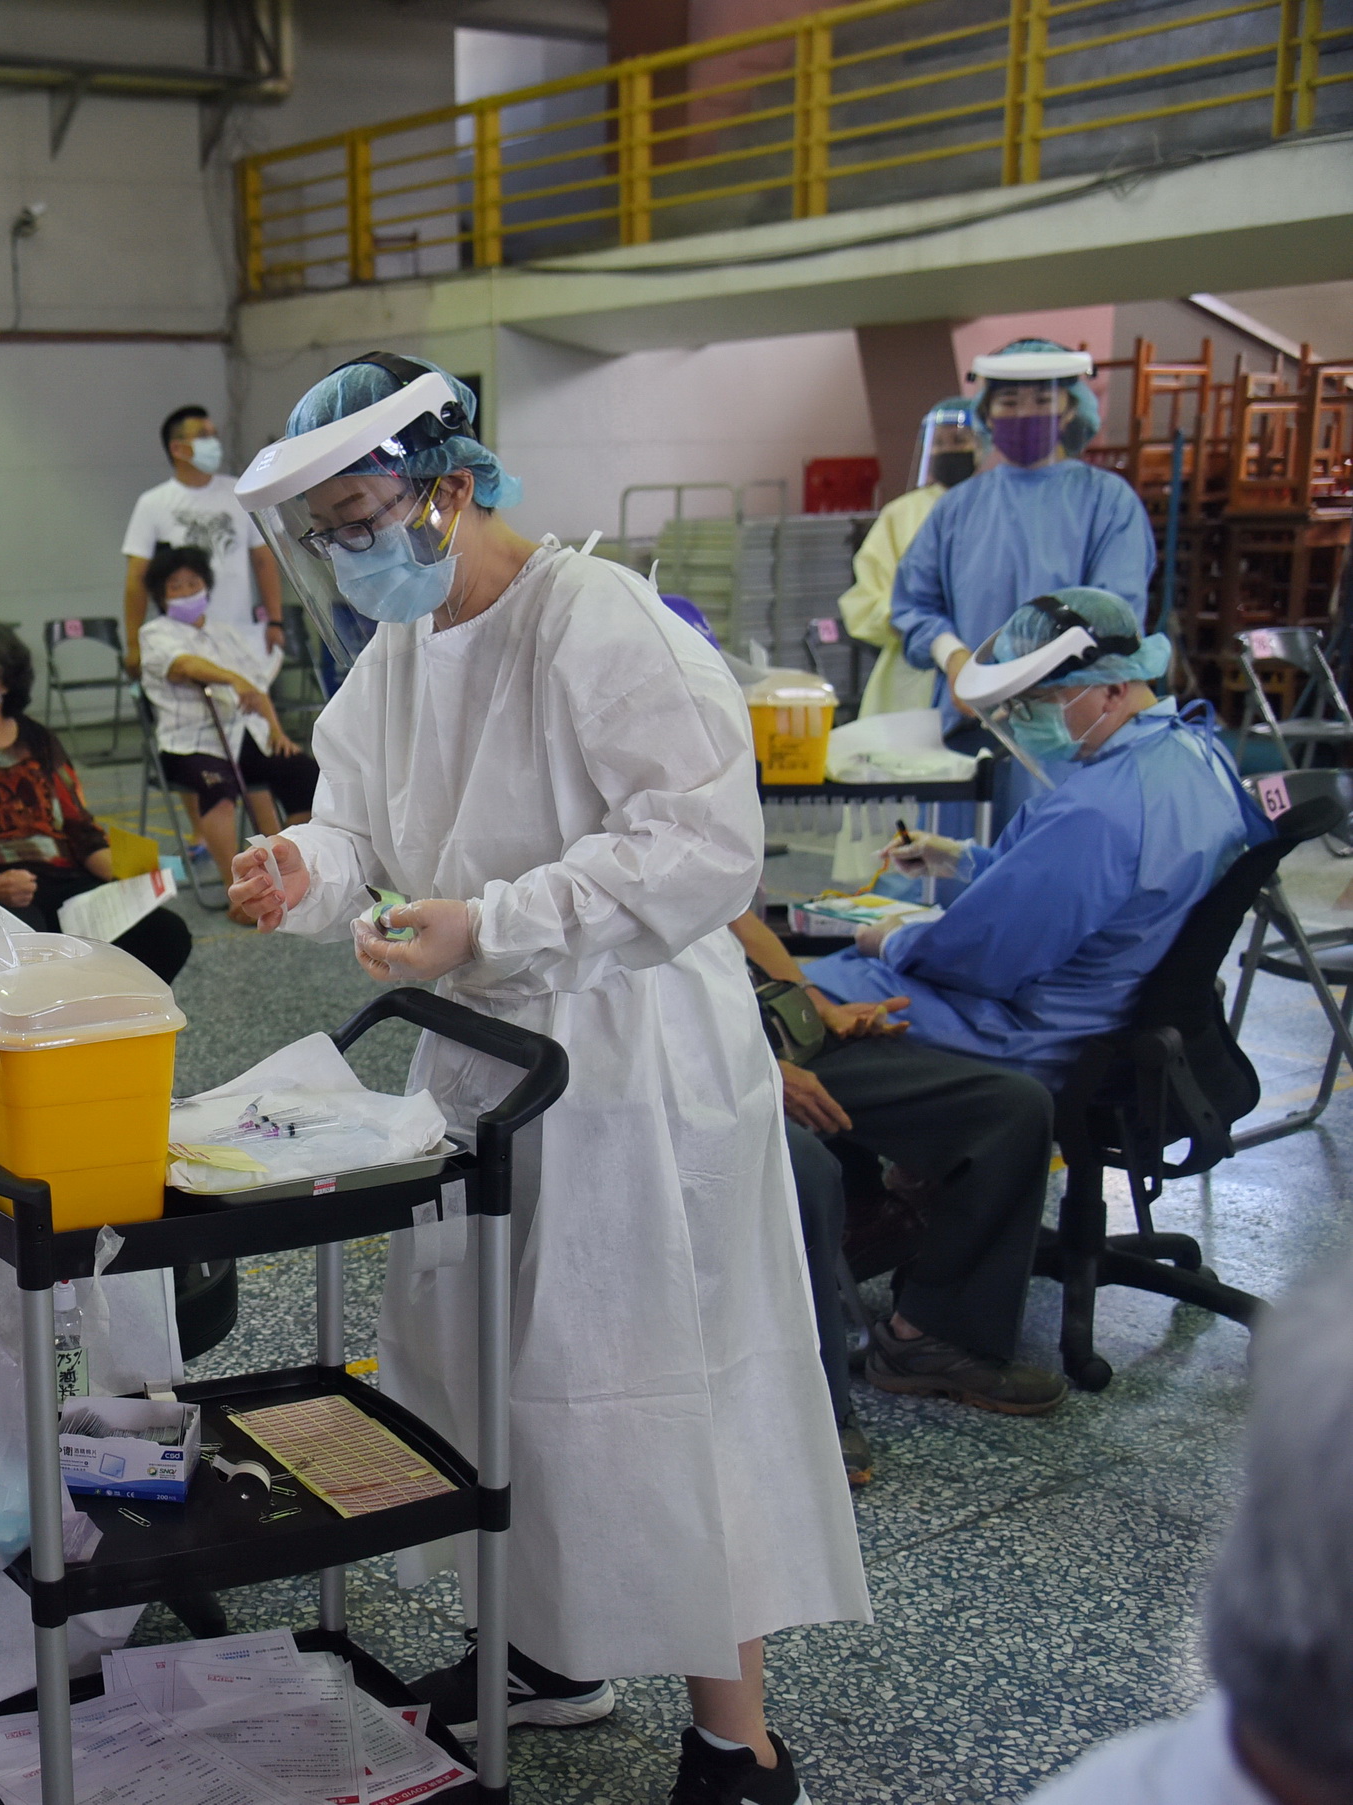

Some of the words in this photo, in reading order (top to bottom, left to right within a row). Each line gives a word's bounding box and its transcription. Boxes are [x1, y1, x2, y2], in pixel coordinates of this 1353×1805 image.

[1265, 787, 1286, 812] 61
[57, 1349, 82, 1370] 75%
[388, 1784, 428, 1805] COVID-19
